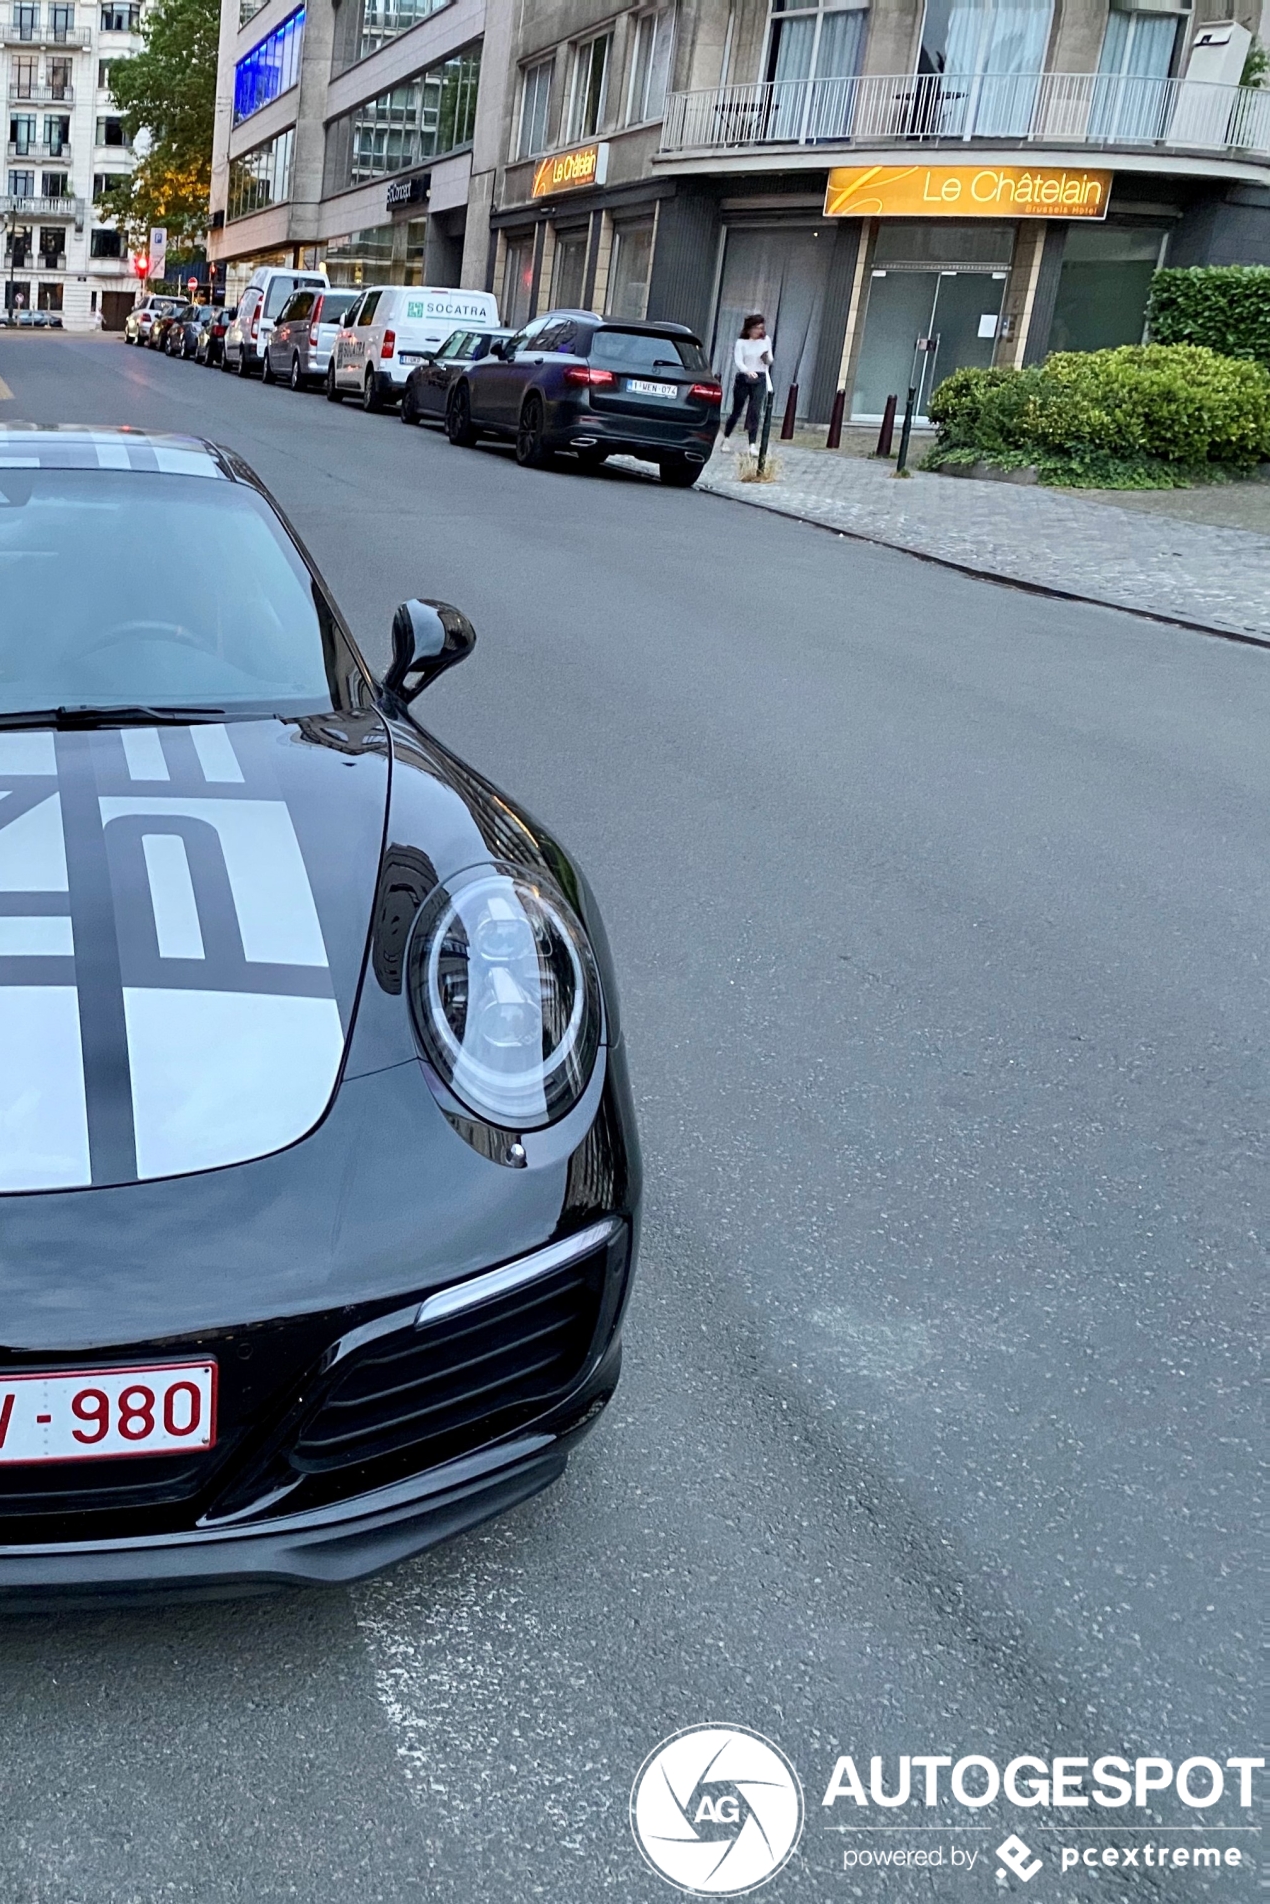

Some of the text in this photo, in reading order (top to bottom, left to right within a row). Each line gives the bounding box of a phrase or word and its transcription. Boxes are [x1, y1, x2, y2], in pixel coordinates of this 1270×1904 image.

[553, 160, 564, 183] Le
[922, 171, 1102, 204] Le Châtelain
[1024, 204, 1097, 215] Brussels Hotel
[427, 302, 487, 317] SOCATRA
